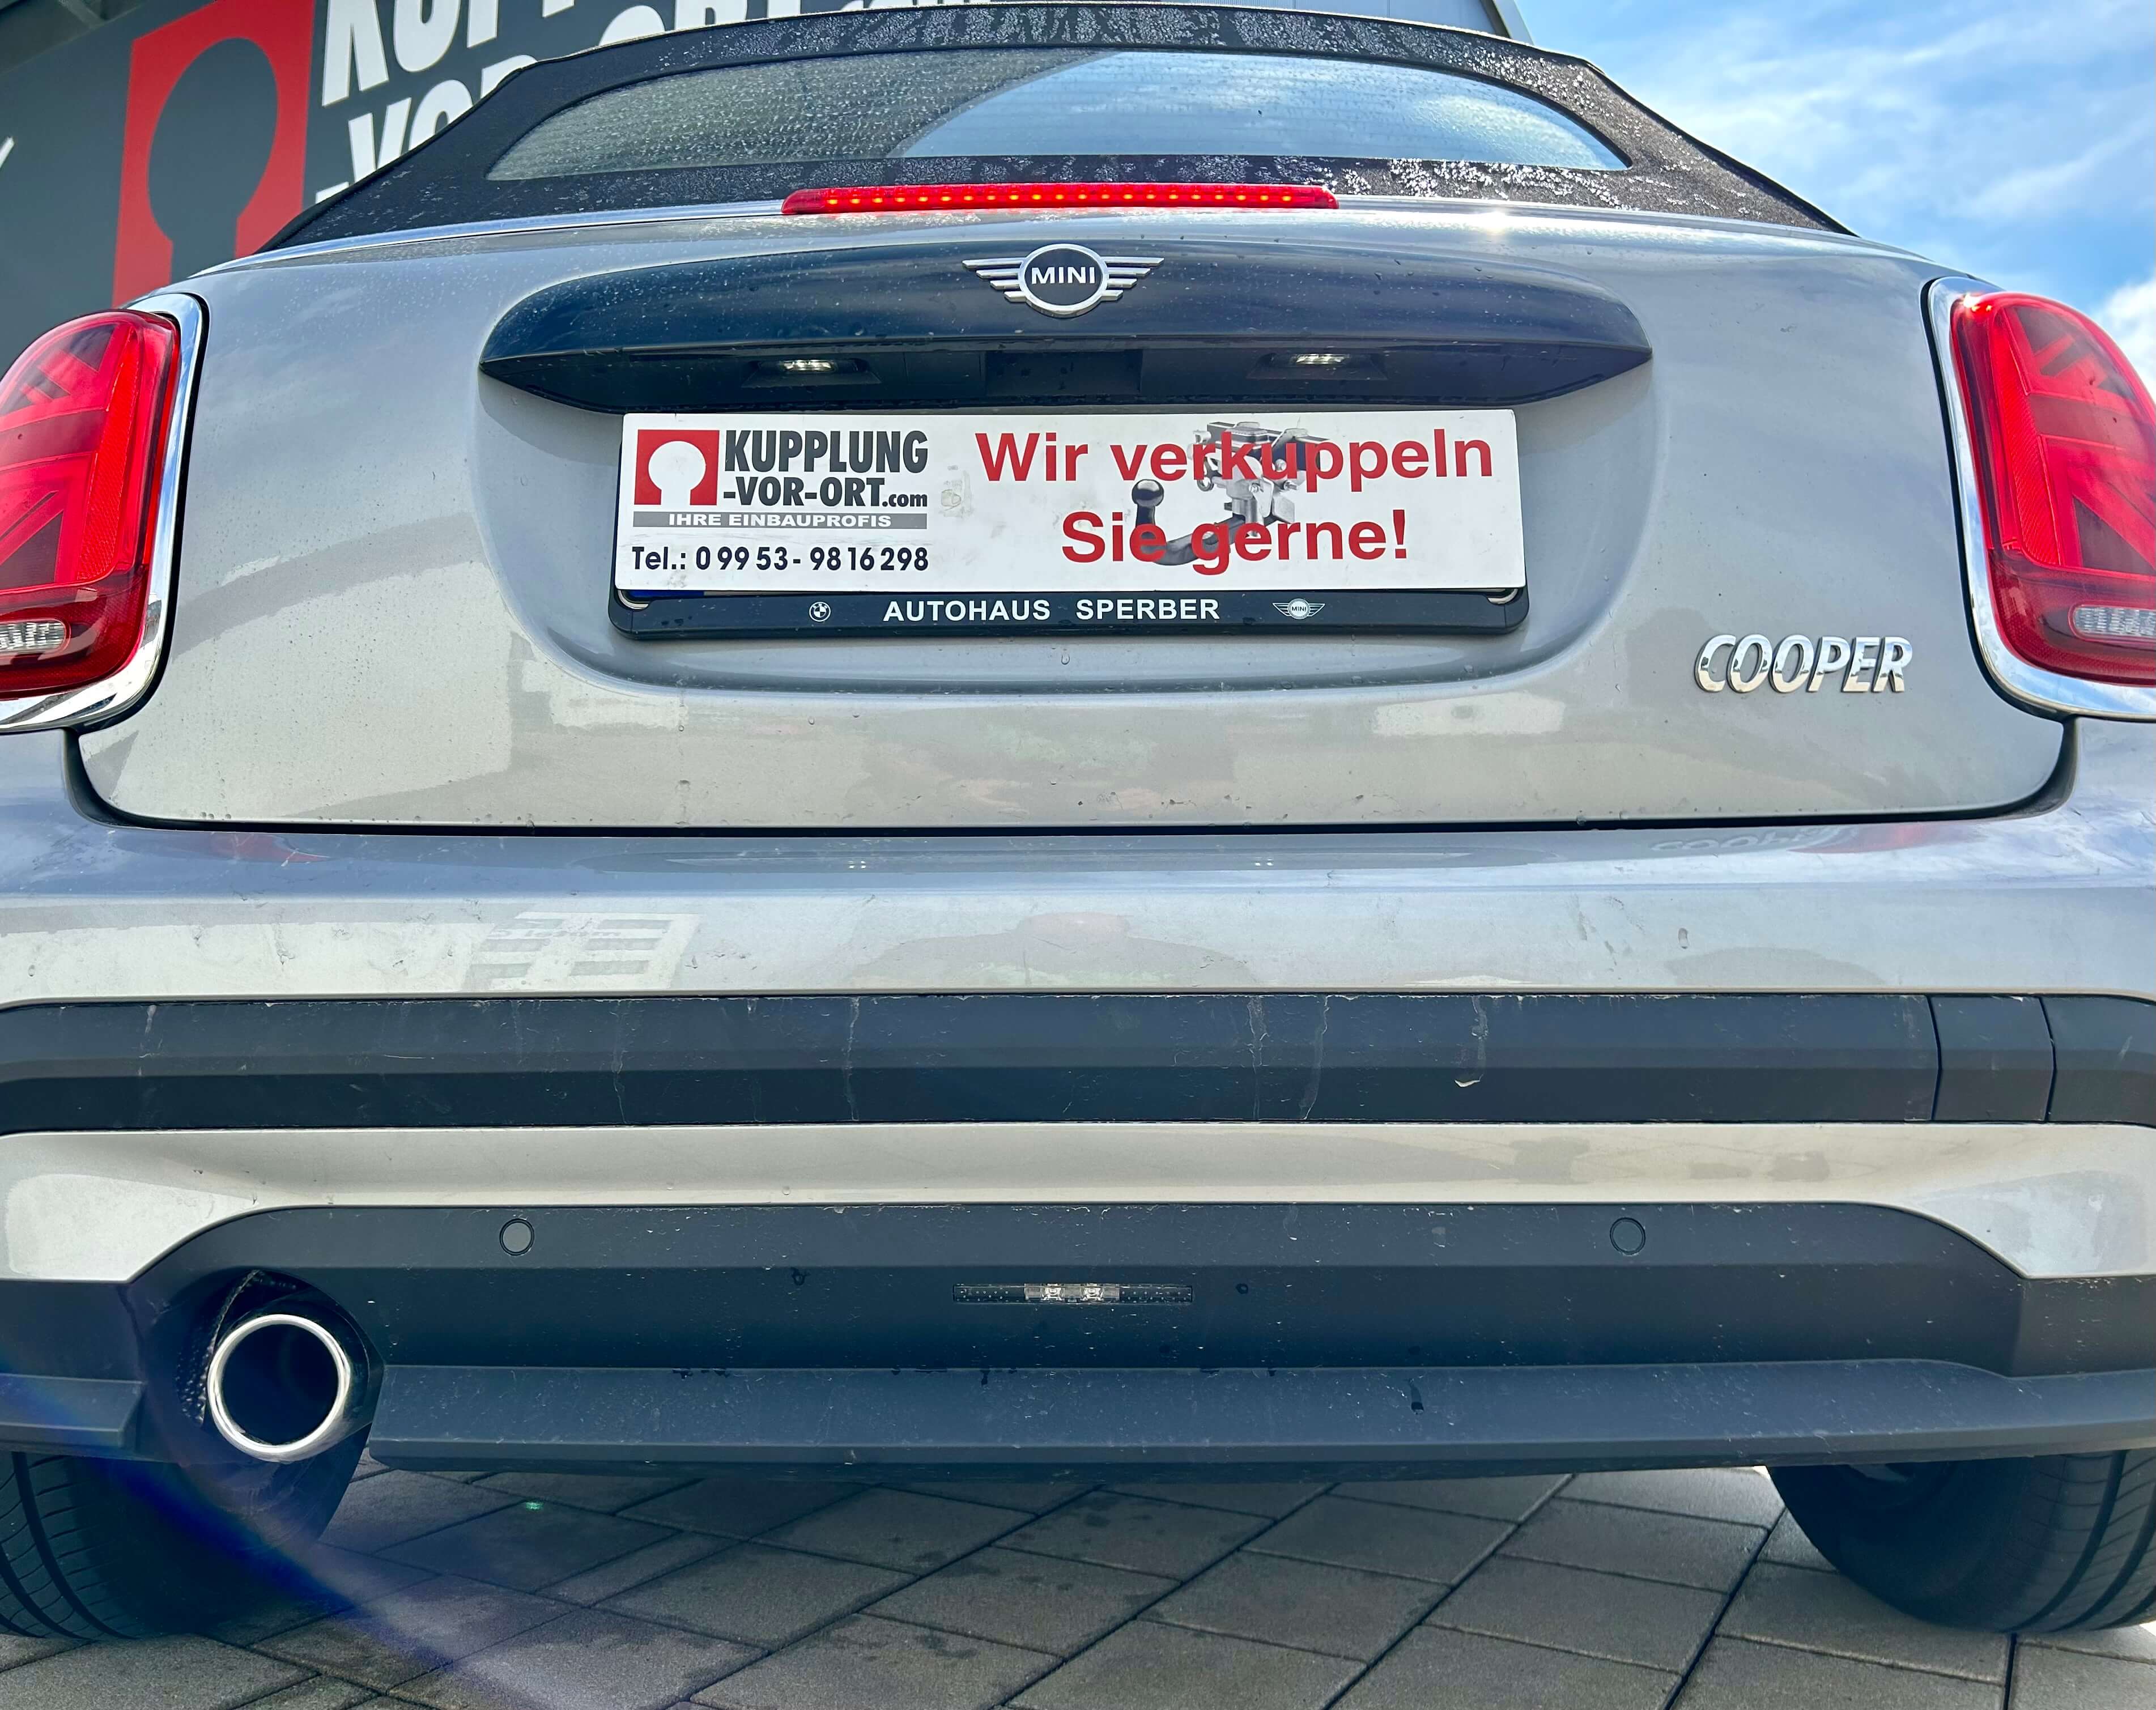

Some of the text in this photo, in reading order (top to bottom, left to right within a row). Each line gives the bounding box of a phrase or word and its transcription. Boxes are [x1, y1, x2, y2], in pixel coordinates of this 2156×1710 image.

[1031, 266, 1096, 284] MINI
[724, 429, 929, 474] KUPPLUNG
[976, 428, 1492, 494] Wir verkuppeln
[669, 513, 892, 528] IHRE EINBAUPROFIS
[631, 546, 687, 571] Tel.:
[1062, 509, 1407, 576] Sie gerne!
[882, 598, 1221, 622] AUTOHAUS SPERBER
[1695, 633, 1913, 694] COOPER
